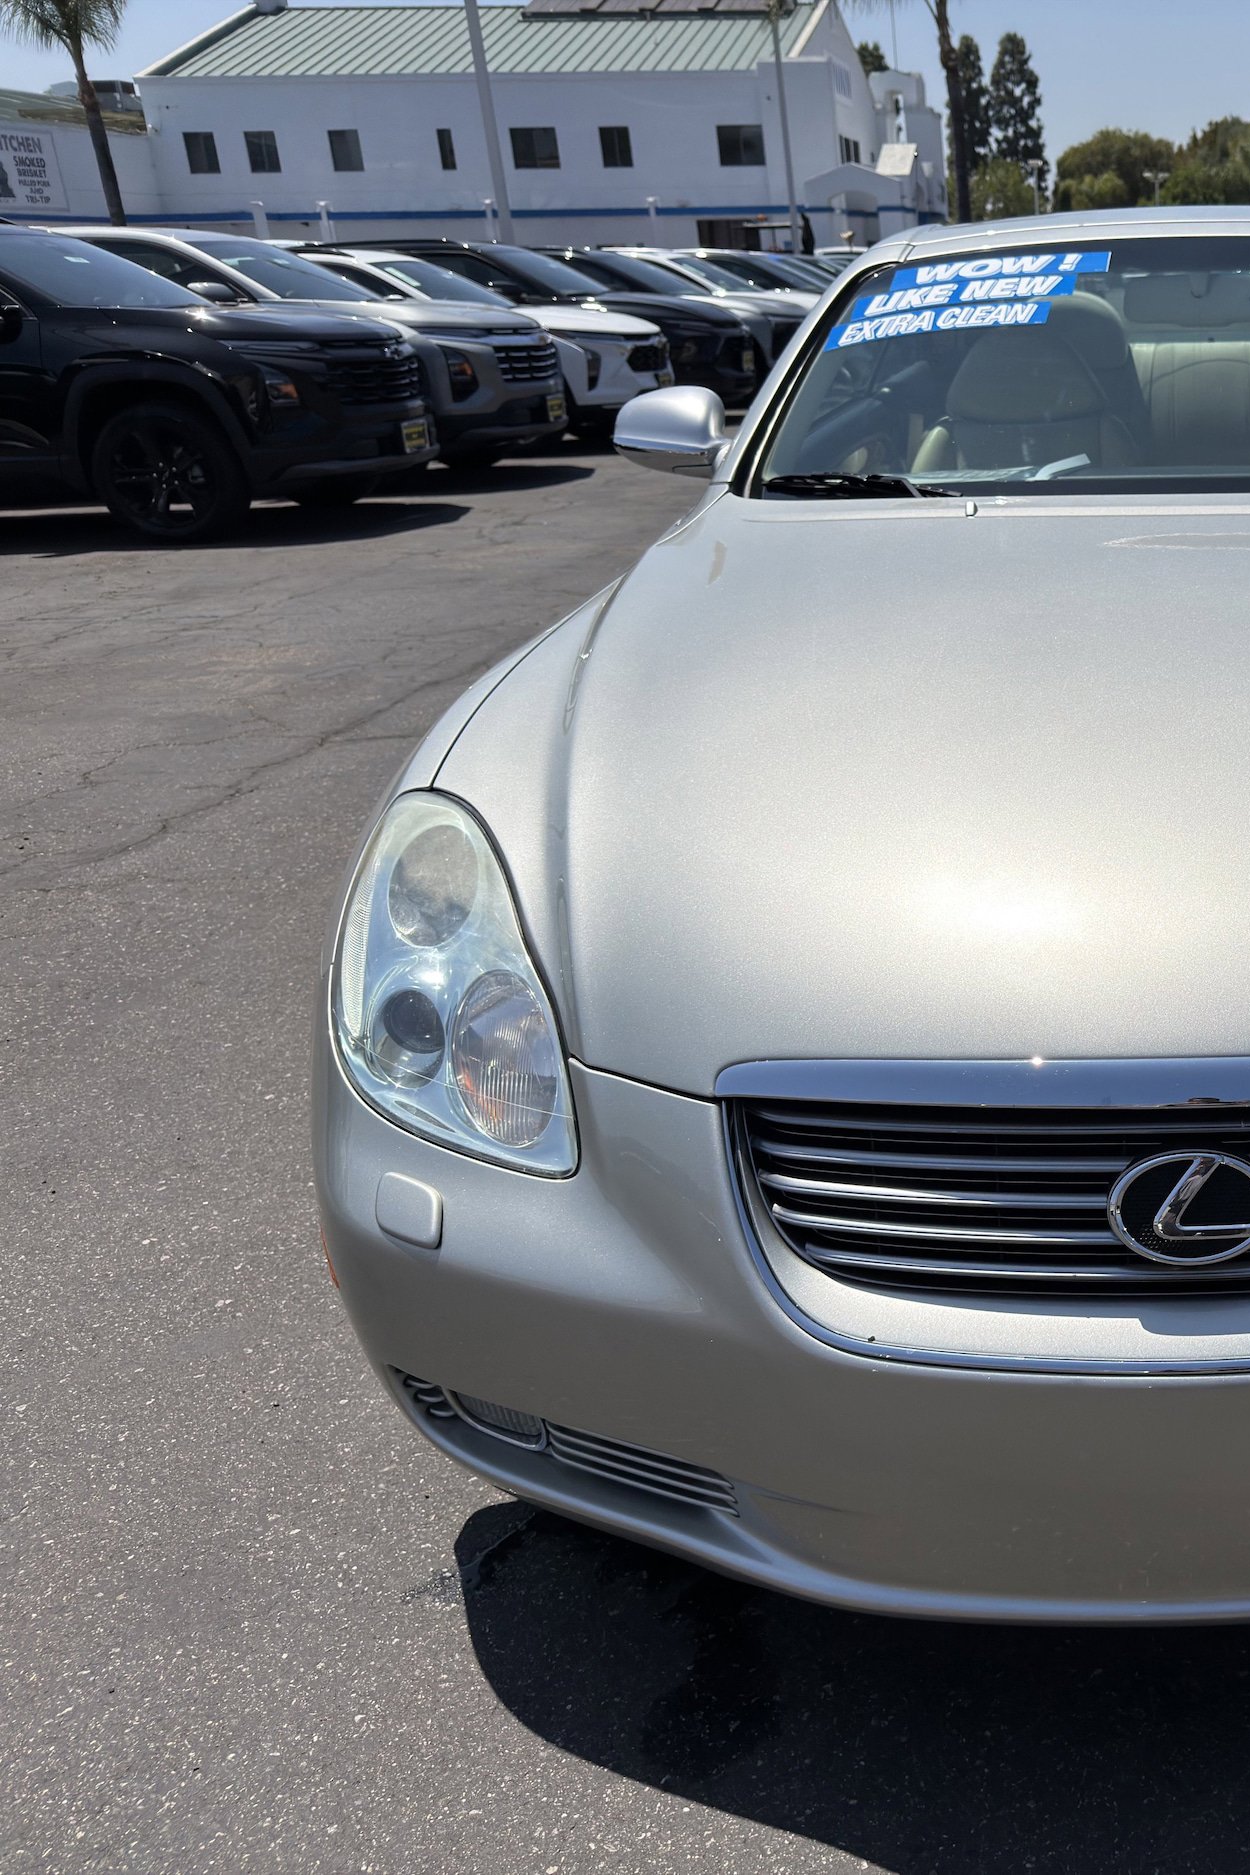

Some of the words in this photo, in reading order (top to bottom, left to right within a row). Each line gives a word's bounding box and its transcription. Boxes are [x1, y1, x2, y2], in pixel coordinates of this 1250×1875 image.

[13, 155, 46, 168] SMOKED
[17, 168, 47, 178] BRISKET
[916, 254, 1056, 285] WOW
[864, 283, 957, 317] LIKE
[959, 275, 1063, 302] NEW
[838, 311, 935, 347] EXTRA
[936, 303, 1039, 328] CLEAN
